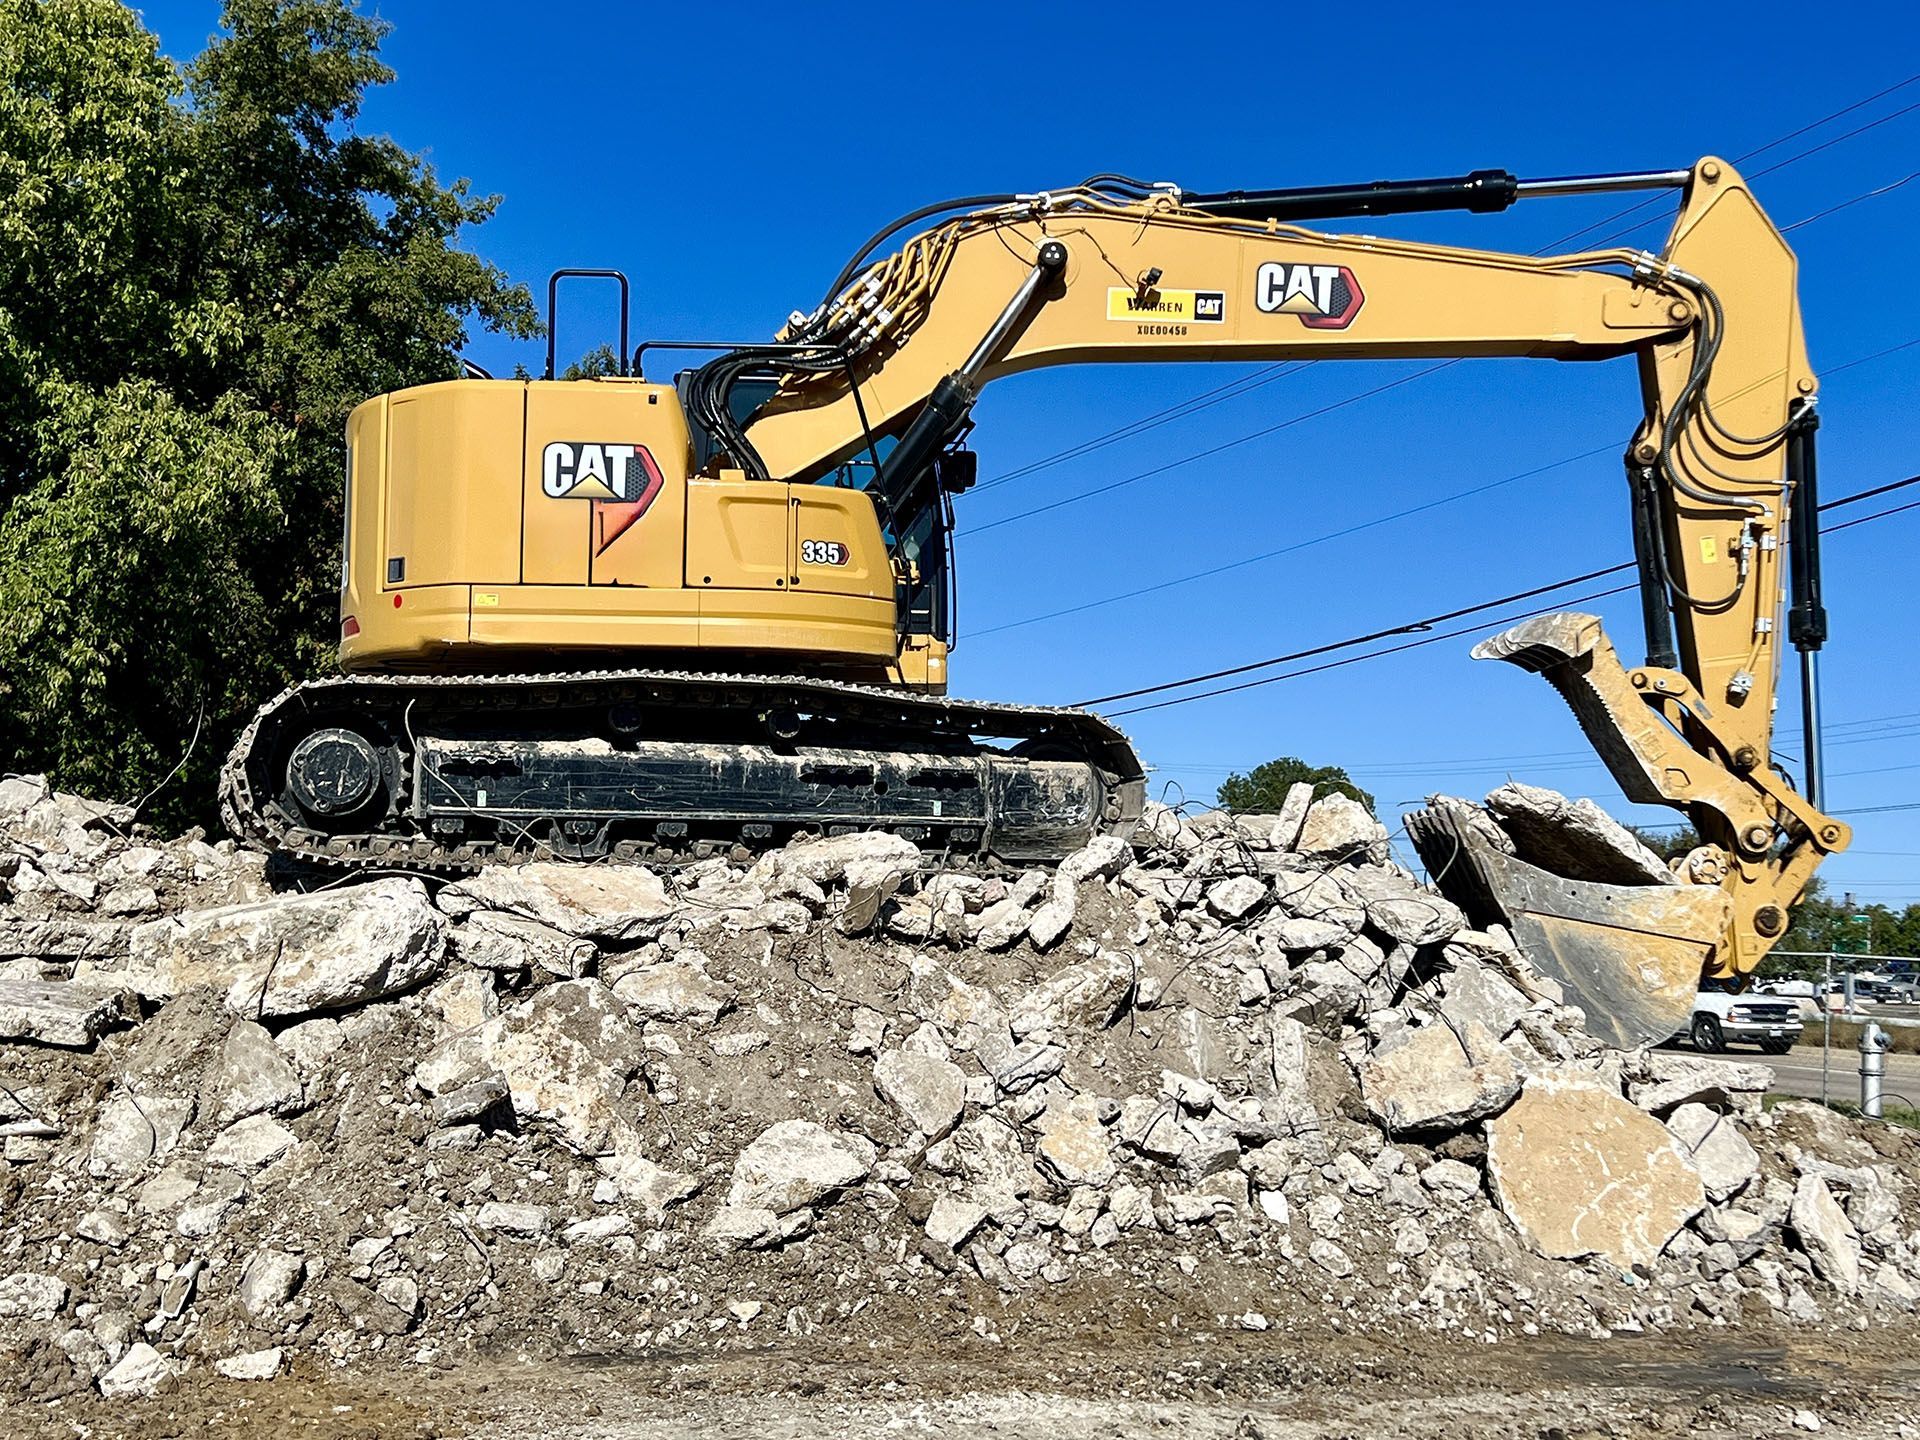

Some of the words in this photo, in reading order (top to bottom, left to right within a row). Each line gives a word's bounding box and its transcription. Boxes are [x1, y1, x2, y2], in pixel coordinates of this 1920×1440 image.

[1196, 298, 1222, 315] CAT
[1257, 262, 1340, 315] CAT
[544, 442, 635, 499] CAT
[802, 540, 840, 564] 335
